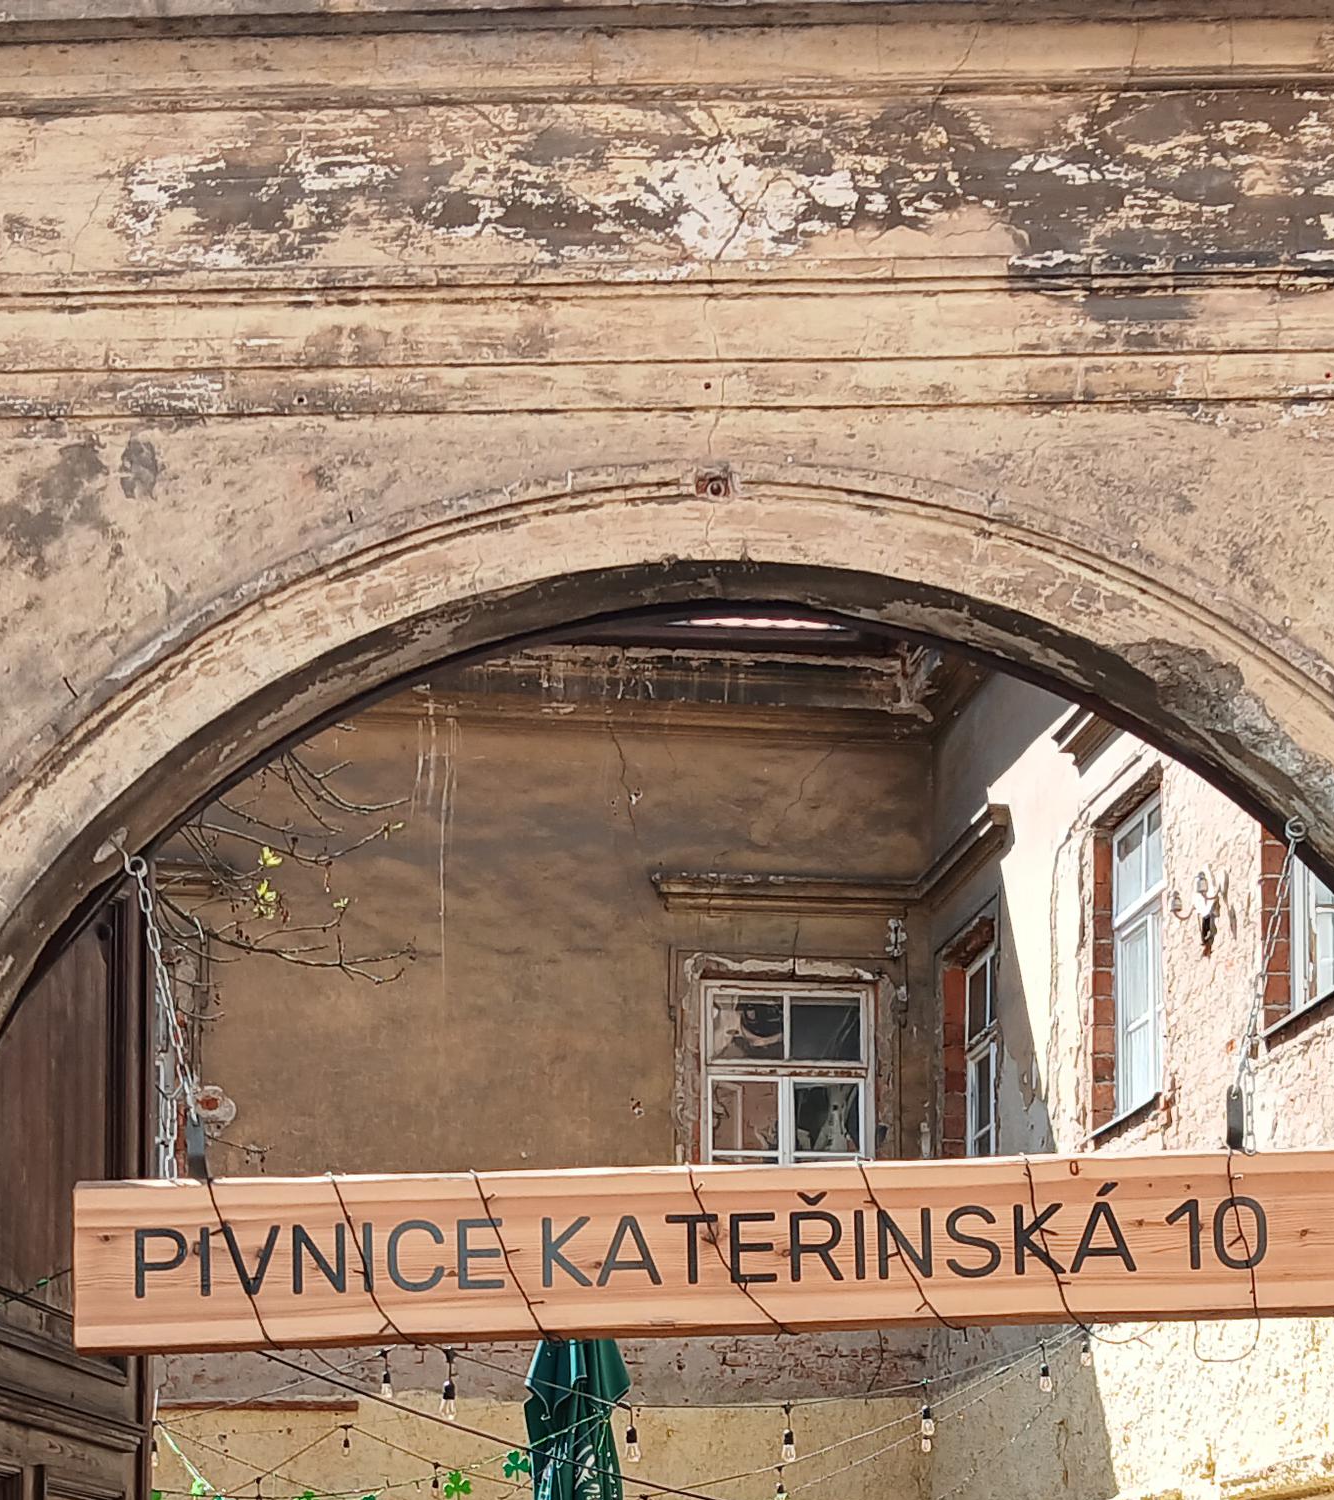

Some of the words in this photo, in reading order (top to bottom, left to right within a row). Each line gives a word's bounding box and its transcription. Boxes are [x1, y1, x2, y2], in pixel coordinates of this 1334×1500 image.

[134, 1217, 505, 1299] PIVNICE
[540, 1182, 1137, 1288] KATEŘINSKÁ
[1165, 1195, 1267, 1271] 10
